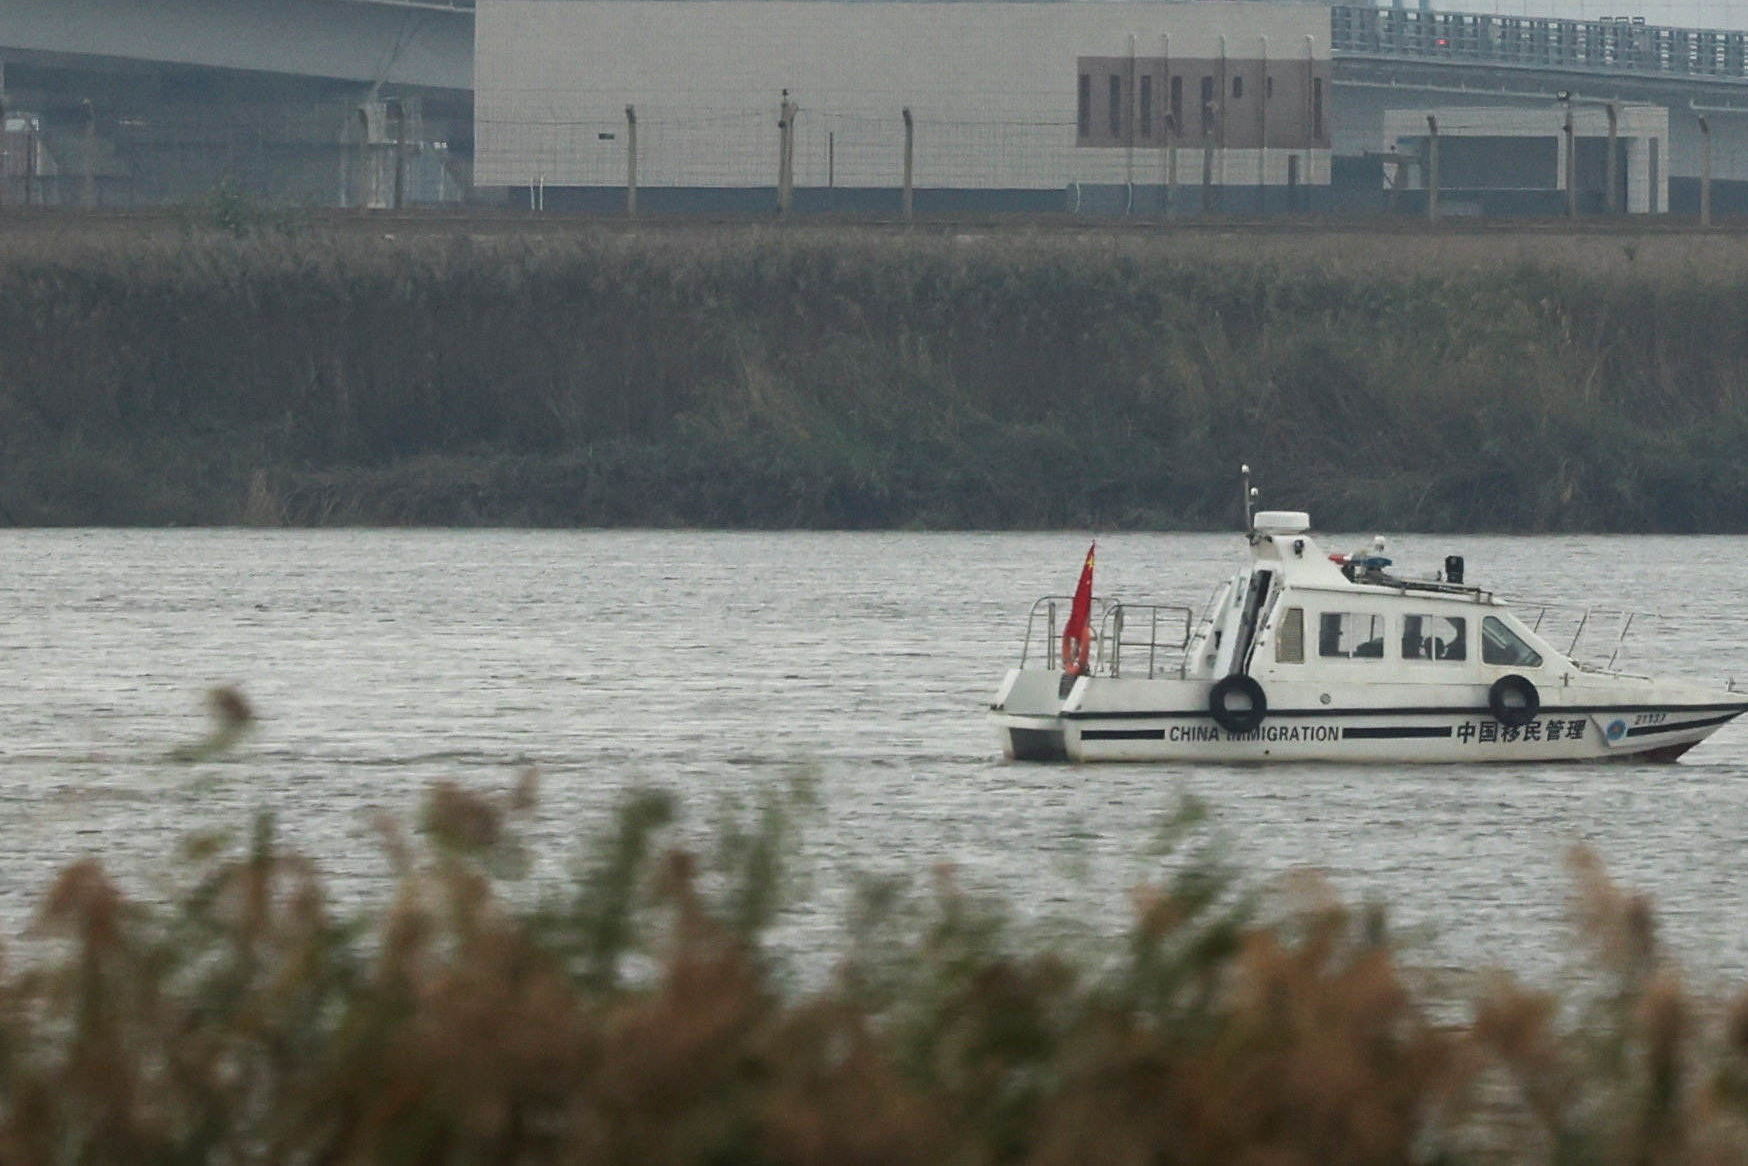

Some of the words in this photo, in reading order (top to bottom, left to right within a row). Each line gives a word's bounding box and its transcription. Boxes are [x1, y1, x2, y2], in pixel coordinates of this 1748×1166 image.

[1169, 726, 1219, 742] CHINA
[1457, 720, 1586, 744] 中国移民管理
